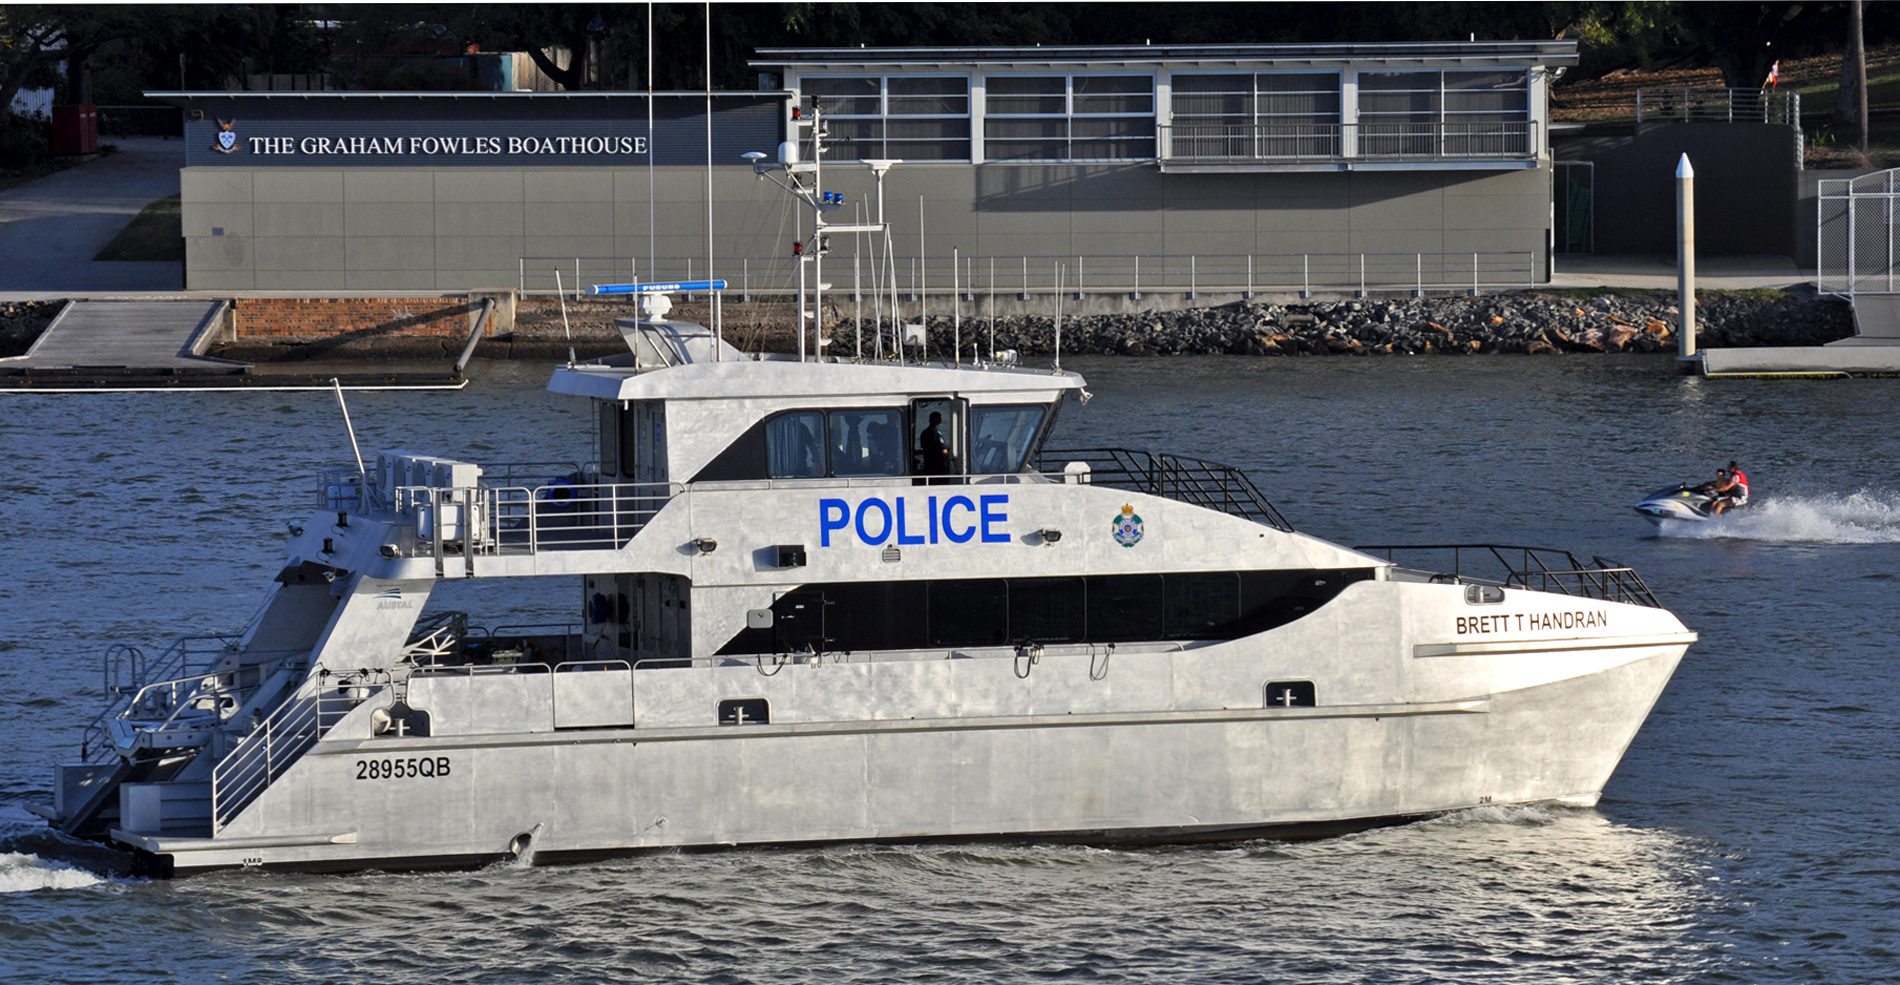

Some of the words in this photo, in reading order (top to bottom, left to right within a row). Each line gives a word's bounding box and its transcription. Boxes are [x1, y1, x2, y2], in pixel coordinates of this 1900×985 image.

[249, 137, 296, 154] THE
[300, 136, 404, 155] GRAHAM
[410, 136, 502, 155] FOWLES
[507, 136, 648, 155] BOATHOUSE
[819, 494, 1012, 548] POLICE
[376, 600, 413, 610] AUSTAL
[1456, 614, 1510, 635] BRETT
[1514, 613, 1525, 632] T
[1529, 609, 1608, 631] HANDRAN
[356, 756, 451, 780] 28955QB
